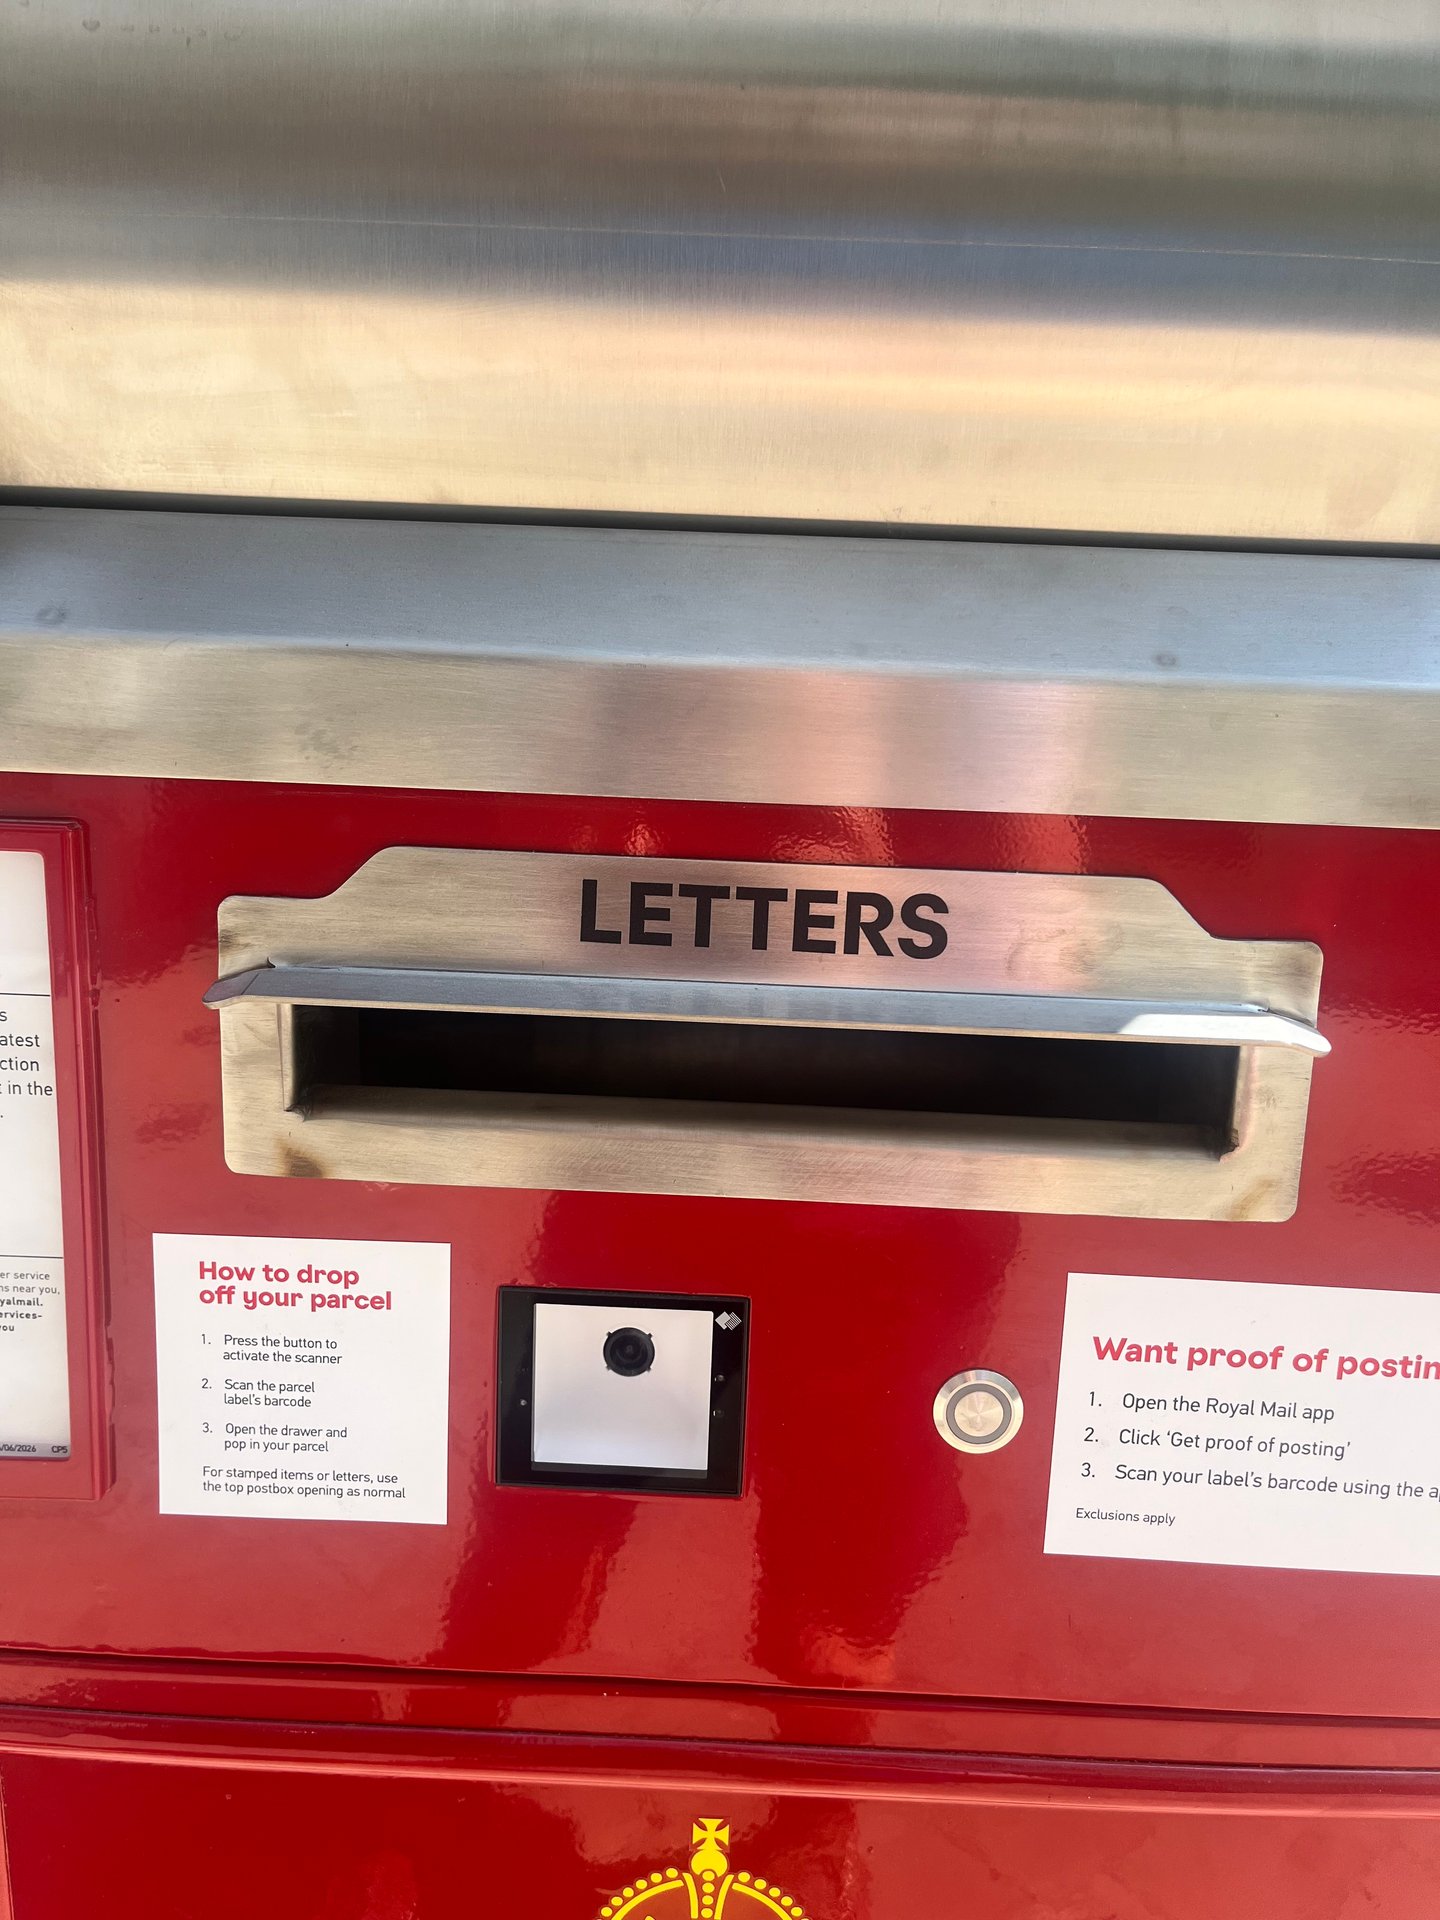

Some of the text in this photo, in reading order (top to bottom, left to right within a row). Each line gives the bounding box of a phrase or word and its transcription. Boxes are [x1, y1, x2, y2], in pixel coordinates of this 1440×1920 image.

[580, 878, 949, 960] LETTERS
[0, 1057, 40, 1071] ction
[8, 1081, 21, 1095] in
[27, 1081, 53, 1096] the
[13, 1272, 50, 1280] service
[199, 1261, 359, 1289] How to drop
[199, 1285, 392, 1312] off your parcel
[201, 1334, 338, 1350] 1. Press the button to
[223, 1350, 343, 1364] activate the scanner
[1093, 1336, 1440, 1380] Want proof of postin
[201, 1378, 315, 1394] 2. Scan the parcel
[264, 1395, 312, 1407] barcode
[1089, 1391, 1335, 1424] 1. Open the Royal Mail app
[202, 1422, 348, 1438] 3. Open the drawer and
[224, 1439, 329, 1453] pop in your parcel
[1084, 1427, 1351, 1461] 2. Click ‘Get proof of posting’
[203, 1466, 398, 1484] For stamped items or letters, use
[1081, 1462, 1095, 1478] 3.
[1115, 1464, 1157, 1481] Scan
[1162, 1471, 1203, 1485] your
[1267, 1473, 1338, 1493] barcode
[1343, 1479, 1390, 1499] using
[1396, 1481, 1424, 1497] the
[1428, 1487, 1440, 1502] a
[203, 1481, 406, 1498] the top postbox opening as normal
[1076, 1508, 1176, 1526] Exclusions apply
